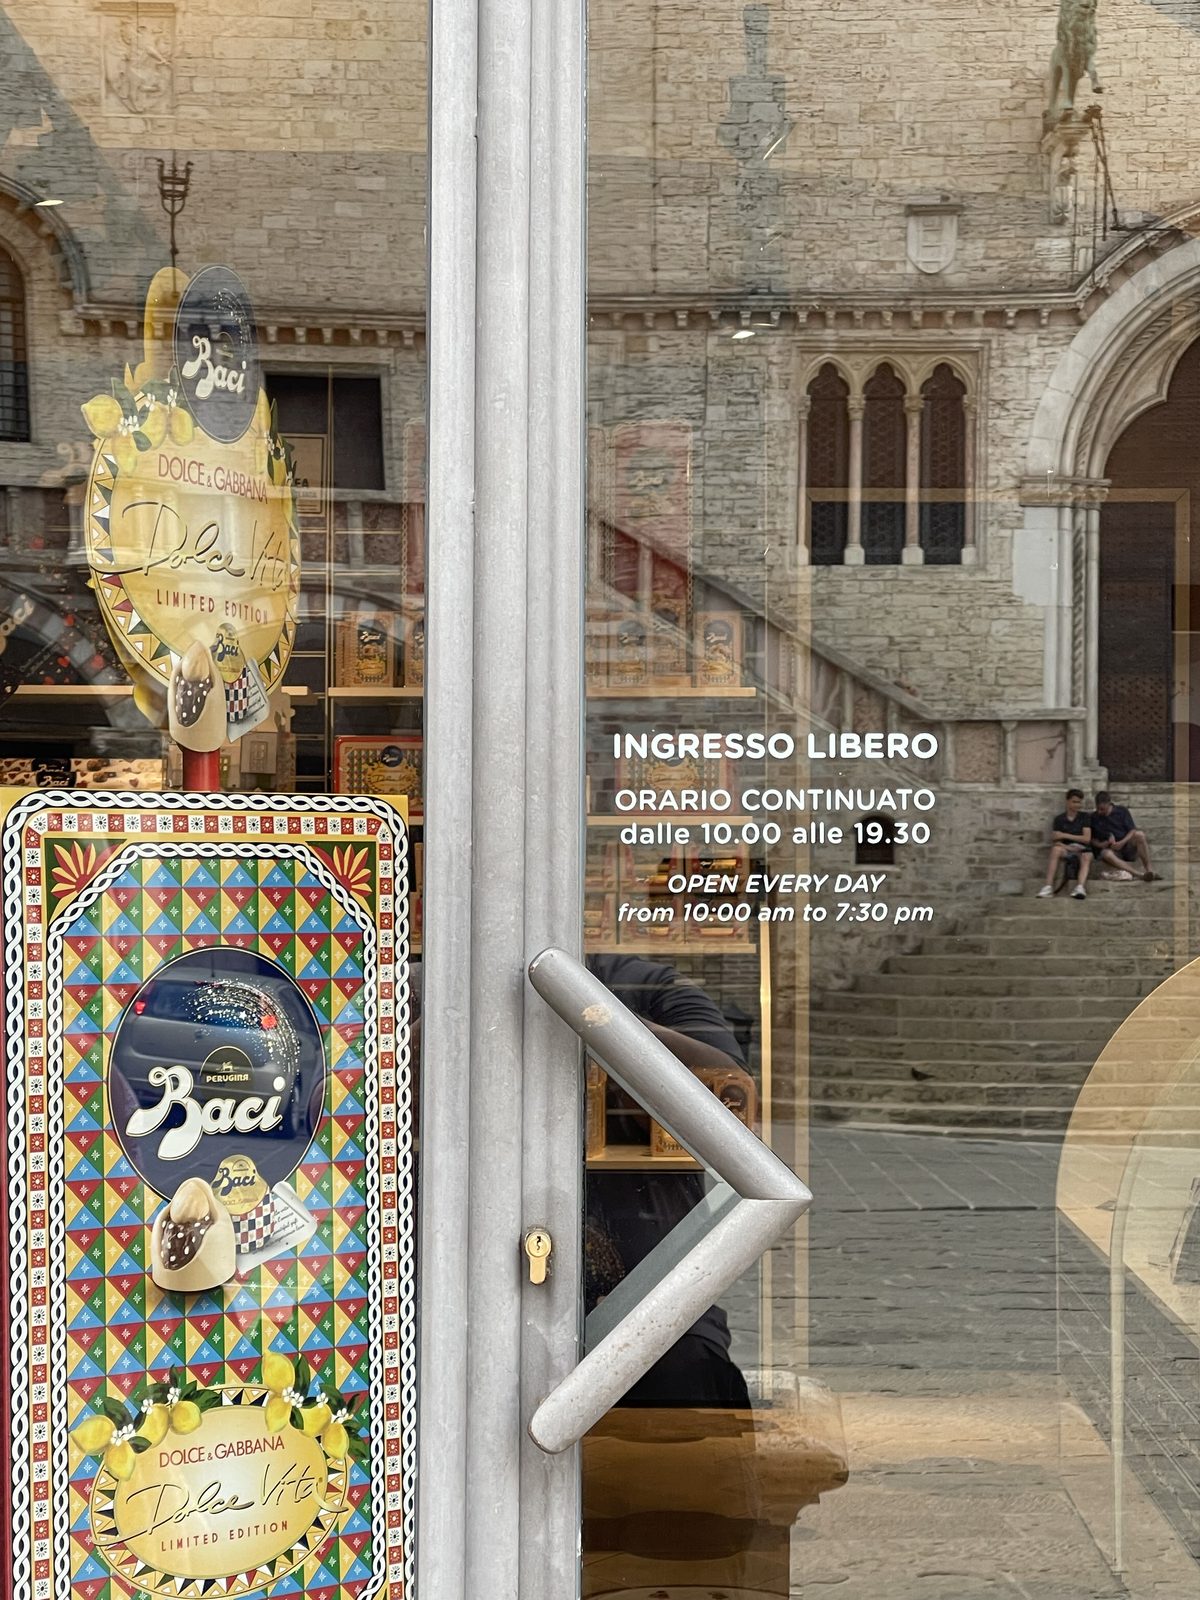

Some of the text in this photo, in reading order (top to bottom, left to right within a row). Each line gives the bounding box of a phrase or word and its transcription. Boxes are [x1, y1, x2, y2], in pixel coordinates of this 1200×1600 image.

[181, 335, 246, 400] Baci
[92, 500, 247, 577] Dolce
[156, 588, 269, 626] LIMITED EDITION
[209, 632, 240, 663] Baci
[612, 731, 938, 761] INGRESSO LIBERO
[614, 787, 936, 812] ORARIO CONTINUATO
[619, 821, 931, 845] dalle 10.00 alle 19.30
[667, 873, 887, 894] OPEN EVERY DAY
[617, 901, 934, 926] from 10:00 am to 7:30 pm
[205, 1073, 250, 1083] PERUGINA
[125, 1066, 283, 1161] Baci
[210, 1166, 256, 1197] Baci
[159, 1445, 205, 1468] DOLCE
[214, 1435, 285, 1460] GABBANA
[92, 1462, 349, 1547] Dolce Vita
[160, 1520, 289, 1552] LIMITED EDITION
